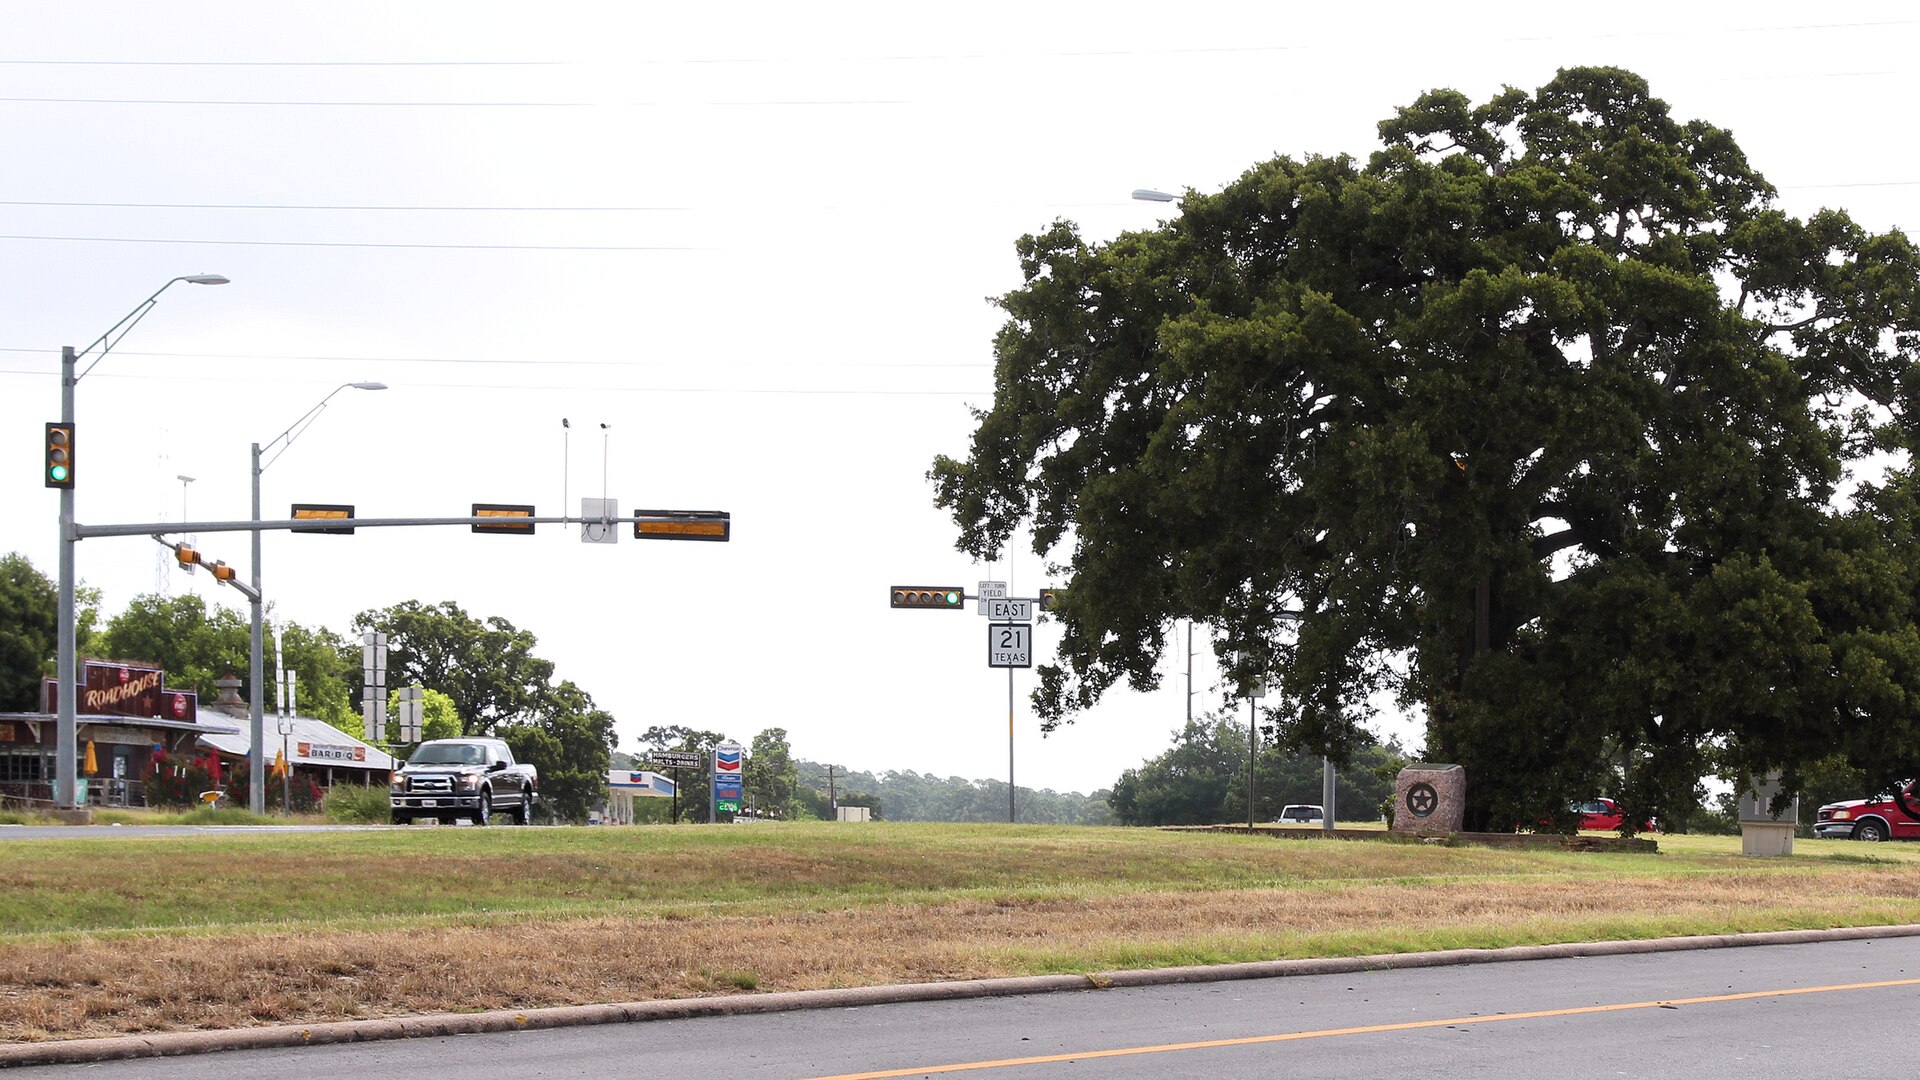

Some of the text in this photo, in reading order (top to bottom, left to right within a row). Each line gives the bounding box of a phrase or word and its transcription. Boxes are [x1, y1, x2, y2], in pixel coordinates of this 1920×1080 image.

[995, 603, 1025, 616] EAST
[1000, 630, 1021, 649] 21
[995, 653, 1026, 662] TEXAS
[85, 671, 160, 710] ROADHOUSE
